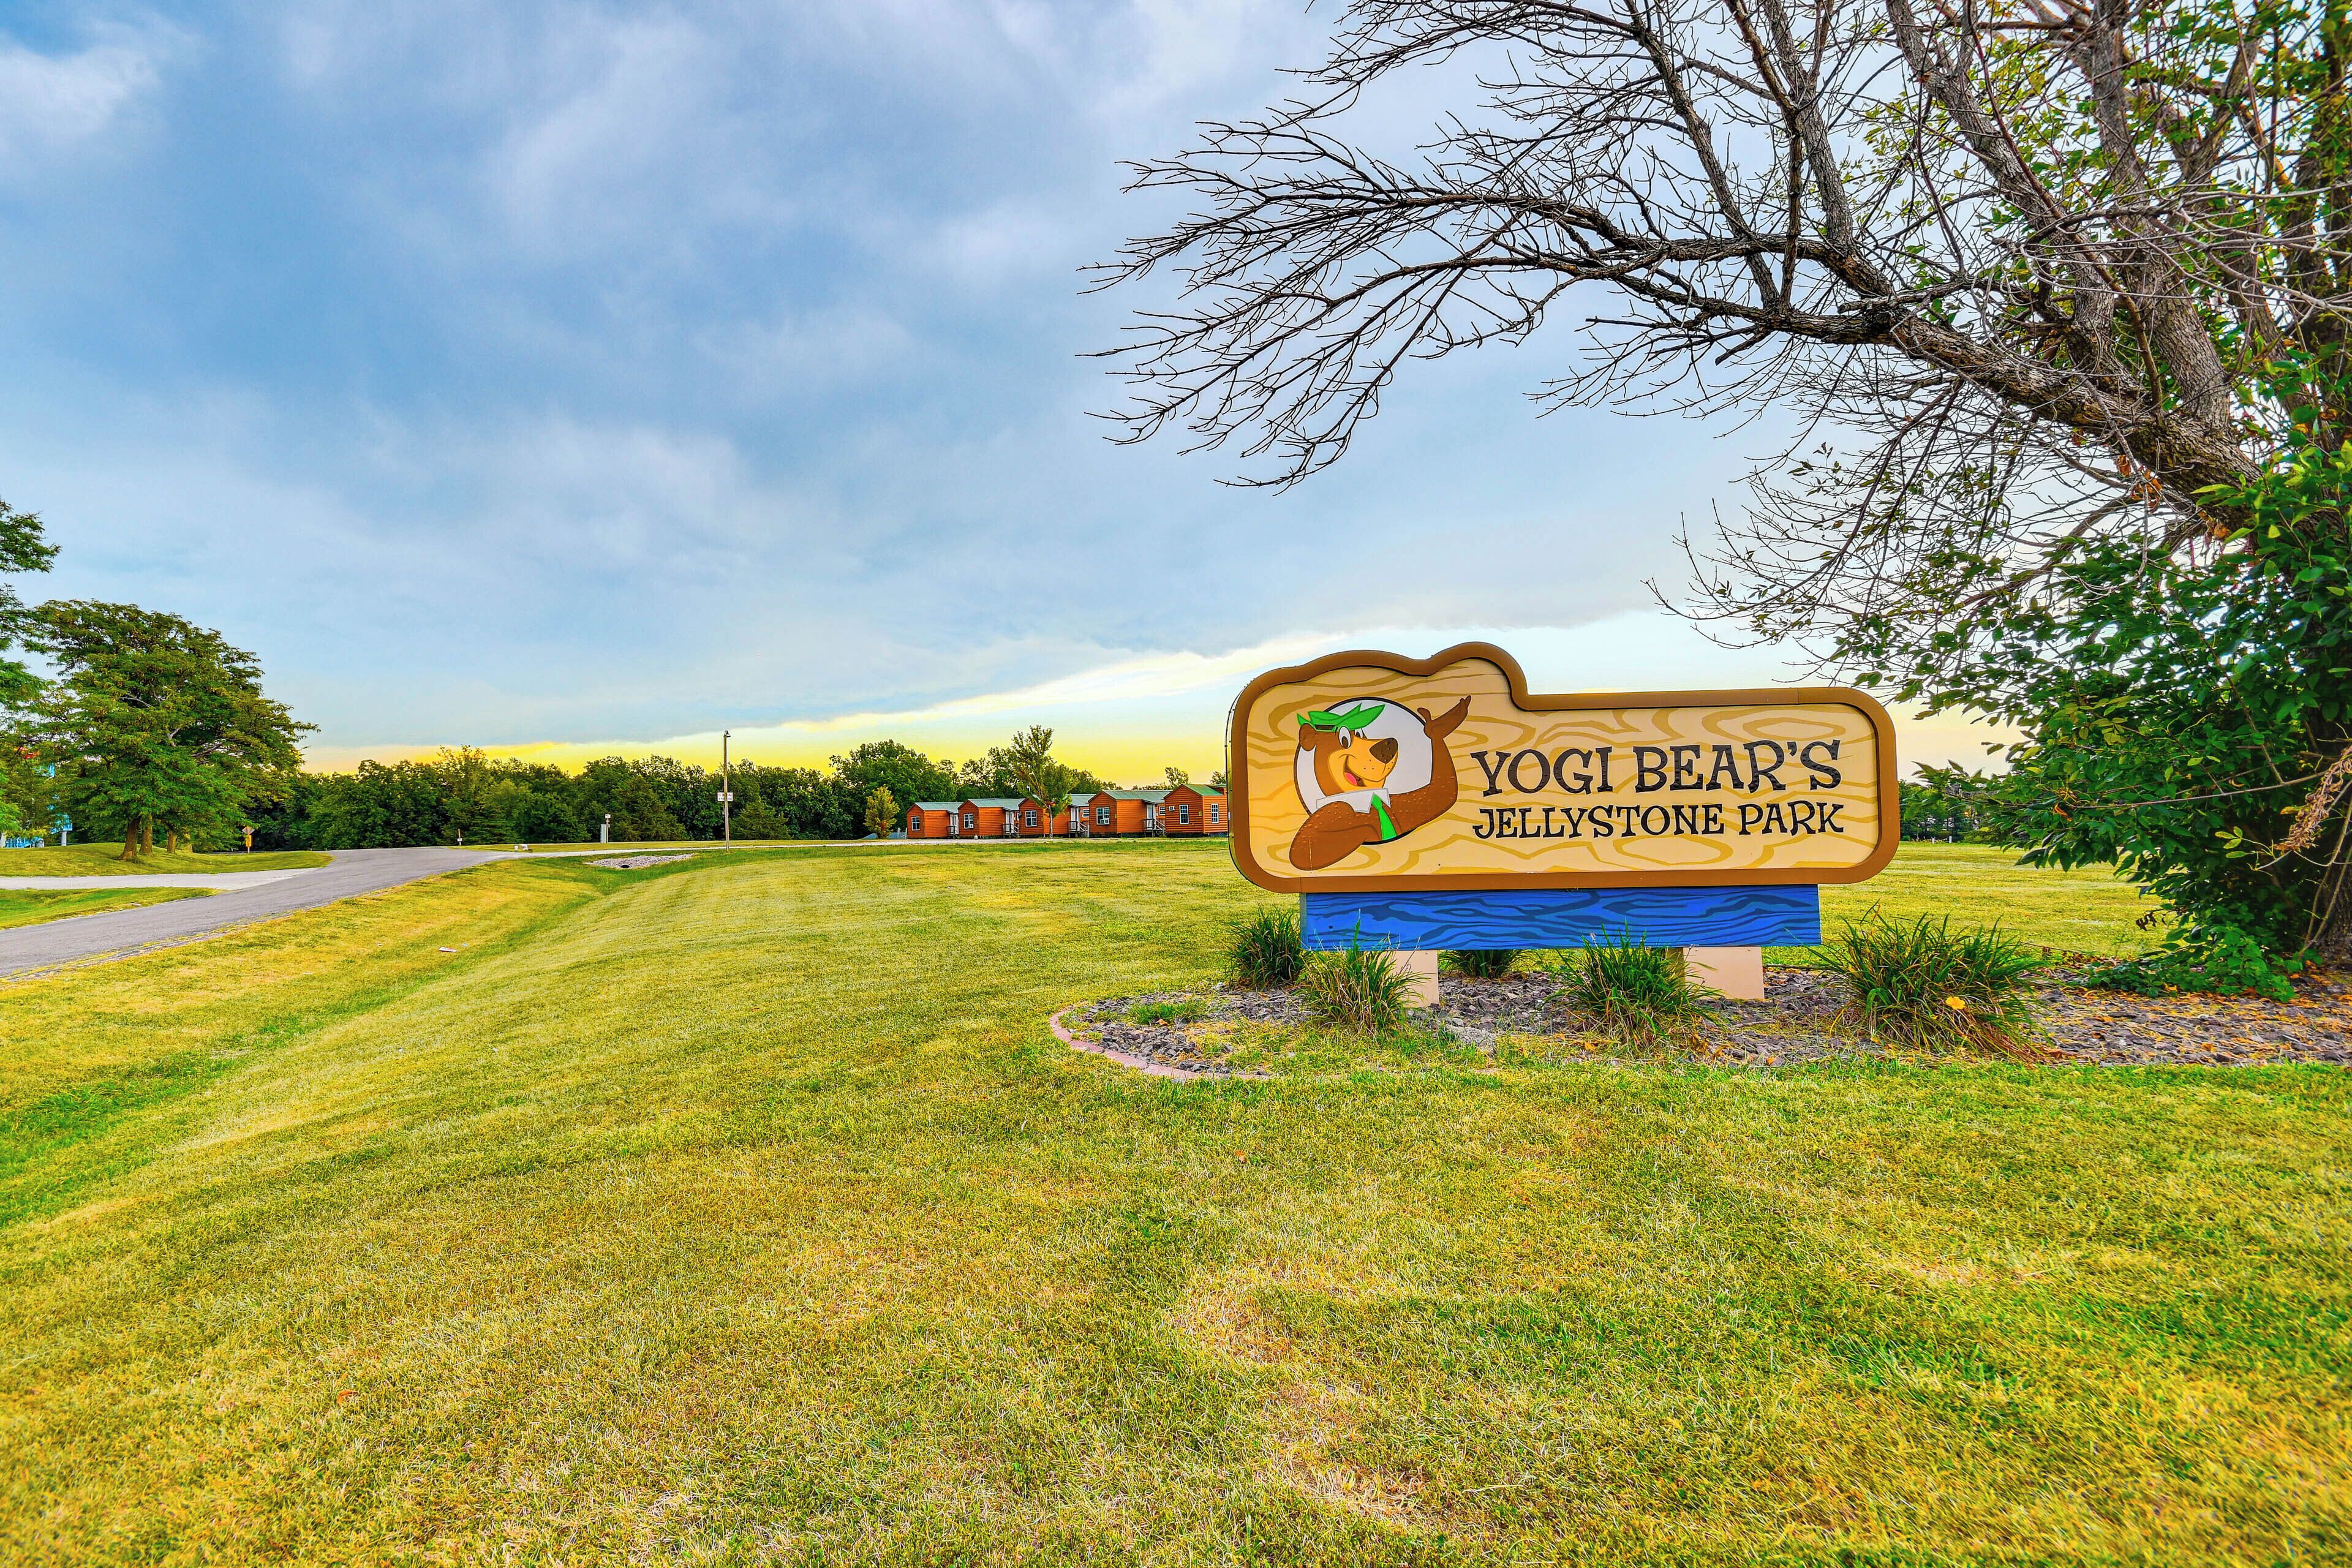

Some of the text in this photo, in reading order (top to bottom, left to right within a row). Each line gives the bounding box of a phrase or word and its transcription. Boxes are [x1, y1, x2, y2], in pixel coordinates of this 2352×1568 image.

[1470, 739, 1841, 797] YOGI BEAR'S
[1472, 800, 1844, 839] JELLYSTONE PARK
